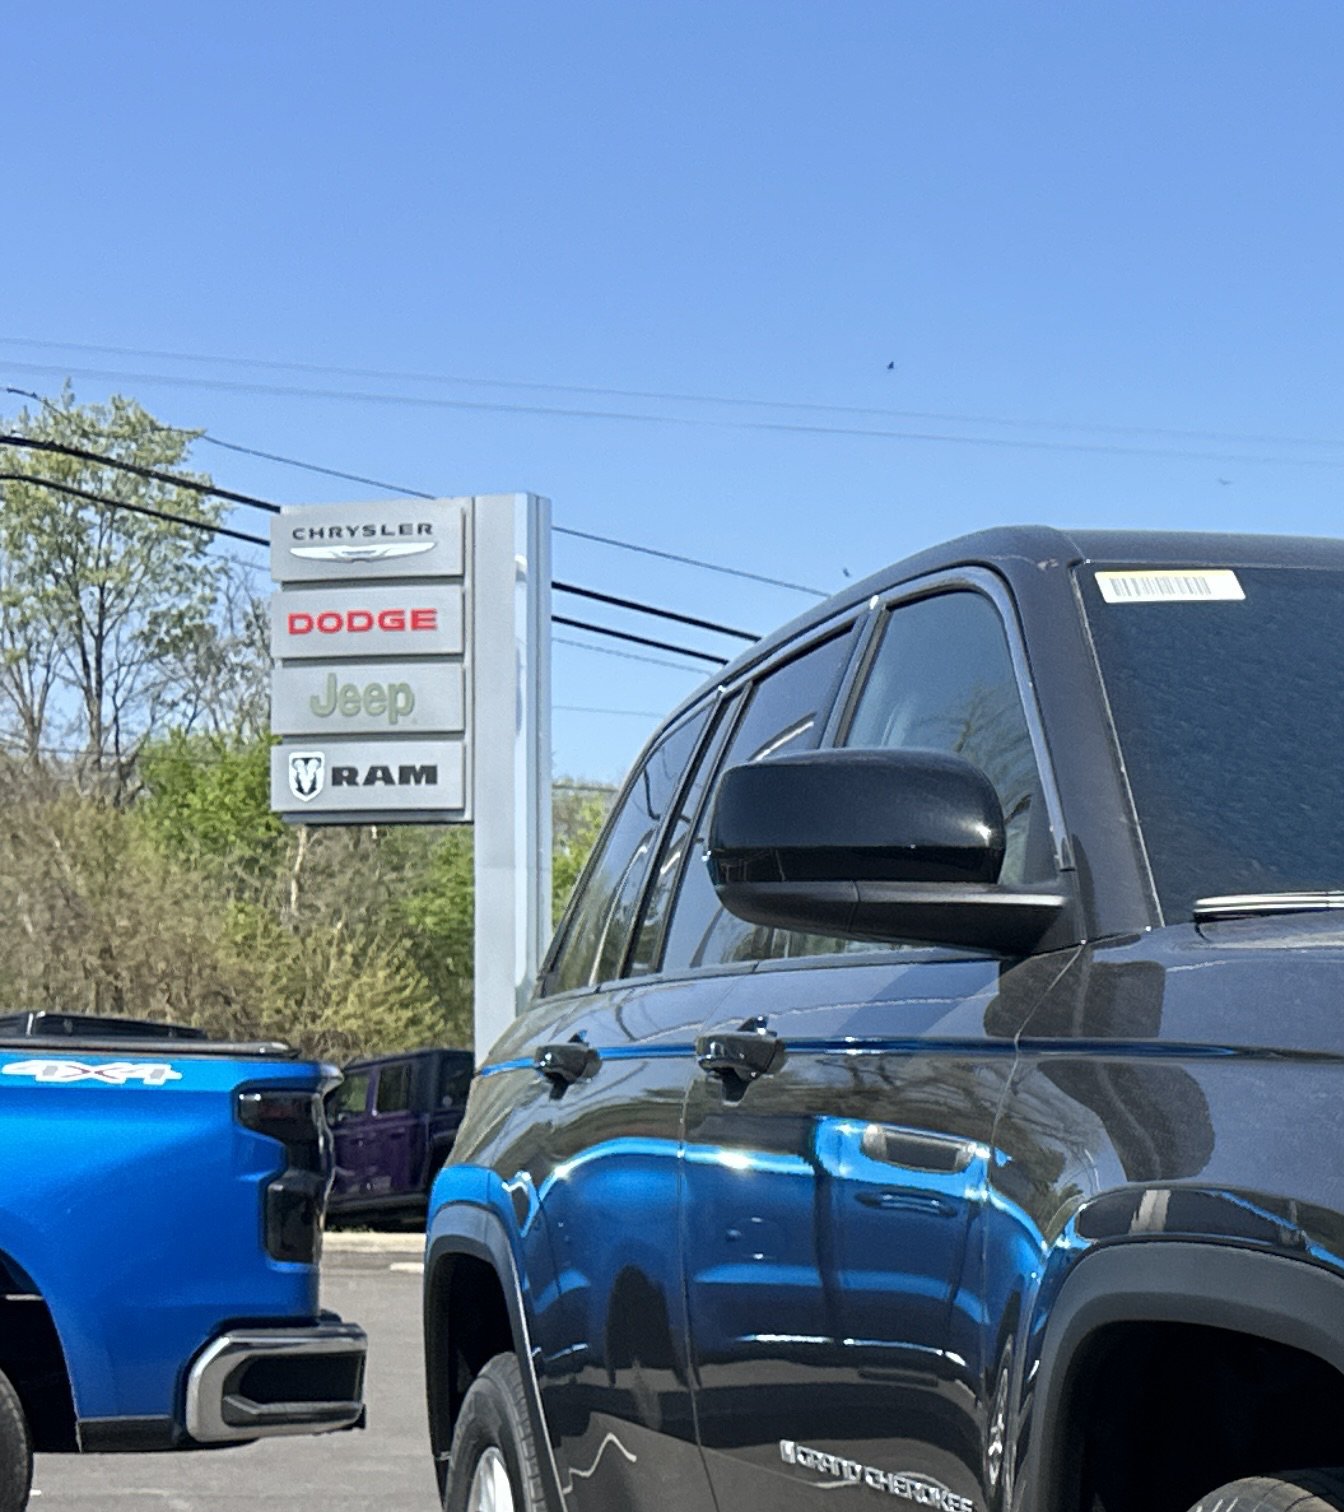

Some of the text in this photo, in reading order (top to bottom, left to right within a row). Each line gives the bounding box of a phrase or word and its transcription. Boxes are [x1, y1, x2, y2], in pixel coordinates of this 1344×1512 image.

[291, 522, 434, 541] CHRYSLER
[287, 607, 438, 635] DODGE
[310, 672, 416, 725] Jeep
[331, 764, 438, 787] RAM
